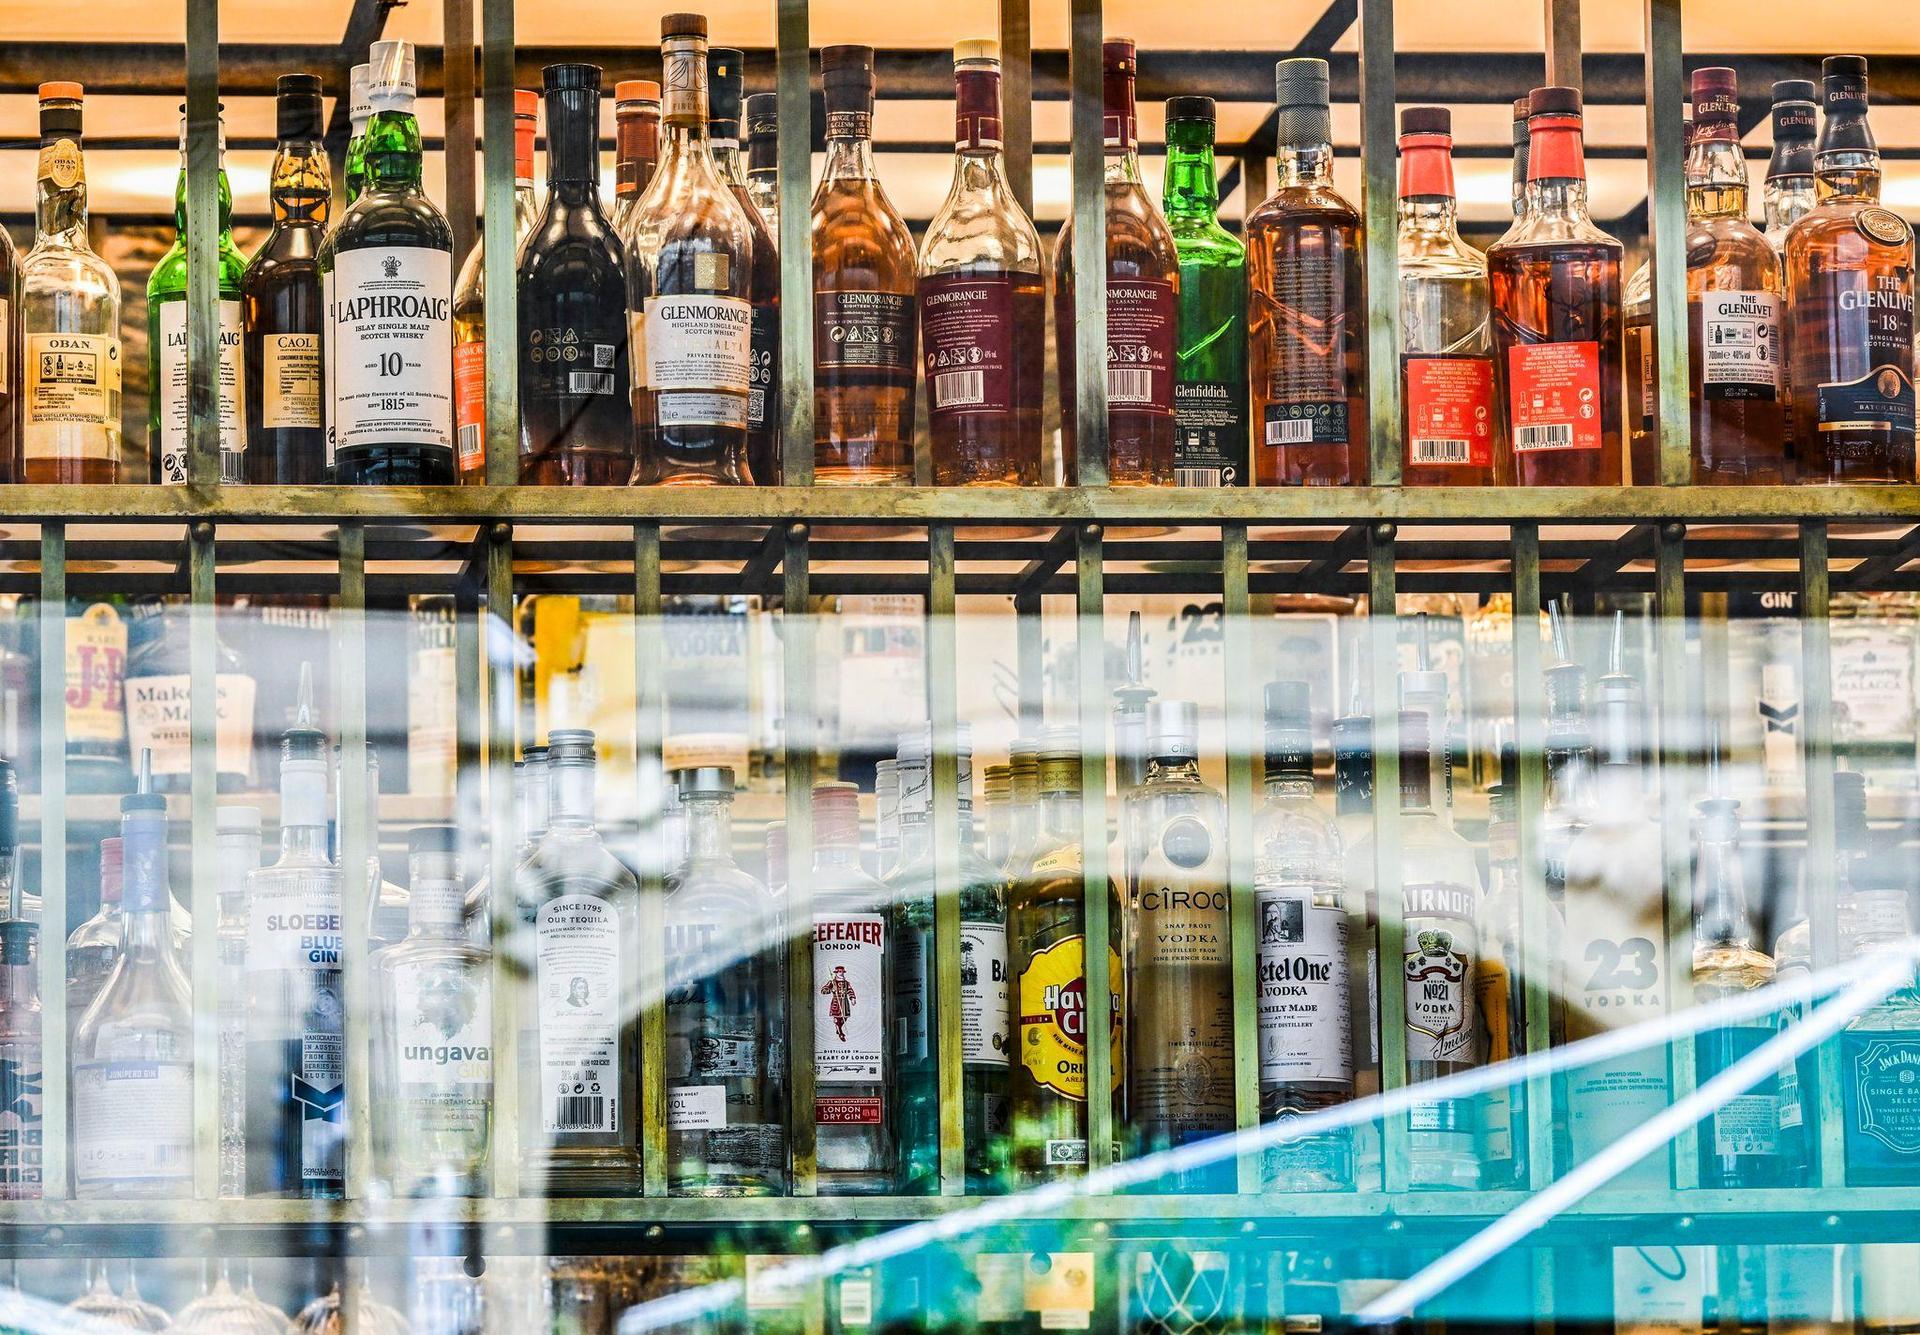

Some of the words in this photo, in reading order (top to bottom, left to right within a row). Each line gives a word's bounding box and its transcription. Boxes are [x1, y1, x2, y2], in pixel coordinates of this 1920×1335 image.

[1715, 94, 1730, 102] THE
[1876, 275, 1900, 290] THE
[838, 293, 903, 306] GLENMORANGIE
[926, 290, 987, 306] GLENMORANGIE
[1740, 294, 1756, 303] THE
[338, 295, 447, 324] LAPHROAIG
[661, 305, 748, 324] GLENMORANGIE
[1718, 303, 1772, 317] GLENLIVET
[355, 324, 376, 332] ISLAY
[410, 323, 430, 331] MALT
[1883, 314, 1897, 331] 18
[714, 329, 736, 337] WHISKY
[1869, 334, 1893, 342] SINGLE
[49, 339, 91, 349] OBAN
[278, 337, 312, 348] CAOL
[713, 352, 735, 360] EDITION
[380, 351, 403, 377] 10
[380, 398, 405, 410] 1815
[1760, 591, 1793, 609] GIN
[1142, 887, 1225, 911] CÎROC
[553, 904, 581, 913] SINCE
[583, 904, 602, 913] 1795
[267, 914, 342, 931] SLOEBE
[547, 916, 567, 924] OUR
[569, 916, 609, 924] TEQUILA
[1158, 935, 1219, 943] VODKA
[309, 950, 338, 963] GIN
[1584, 937, 1659, 991] 23
[1265, 986, 1308, 996] VODKA
[1289, 1003, 1318, 1012] MADE
[1584, 995, 1660, 1008] VODKA
[1415, 1002, 1455, 1014] VODKA
[1189, 1027, 1196, 1038] 5
[1053, 1033, 1064, 1045] RUM
[1064, 1042, 1079, 1053] MADE
[404, 1046, 488, 1065] ungava
[1880, 1053, 1900, 1072] JACK
[1156, 1111, 1192, 1119] PRODUCT
[1883, 1115, 1898, 1124] 70cl
